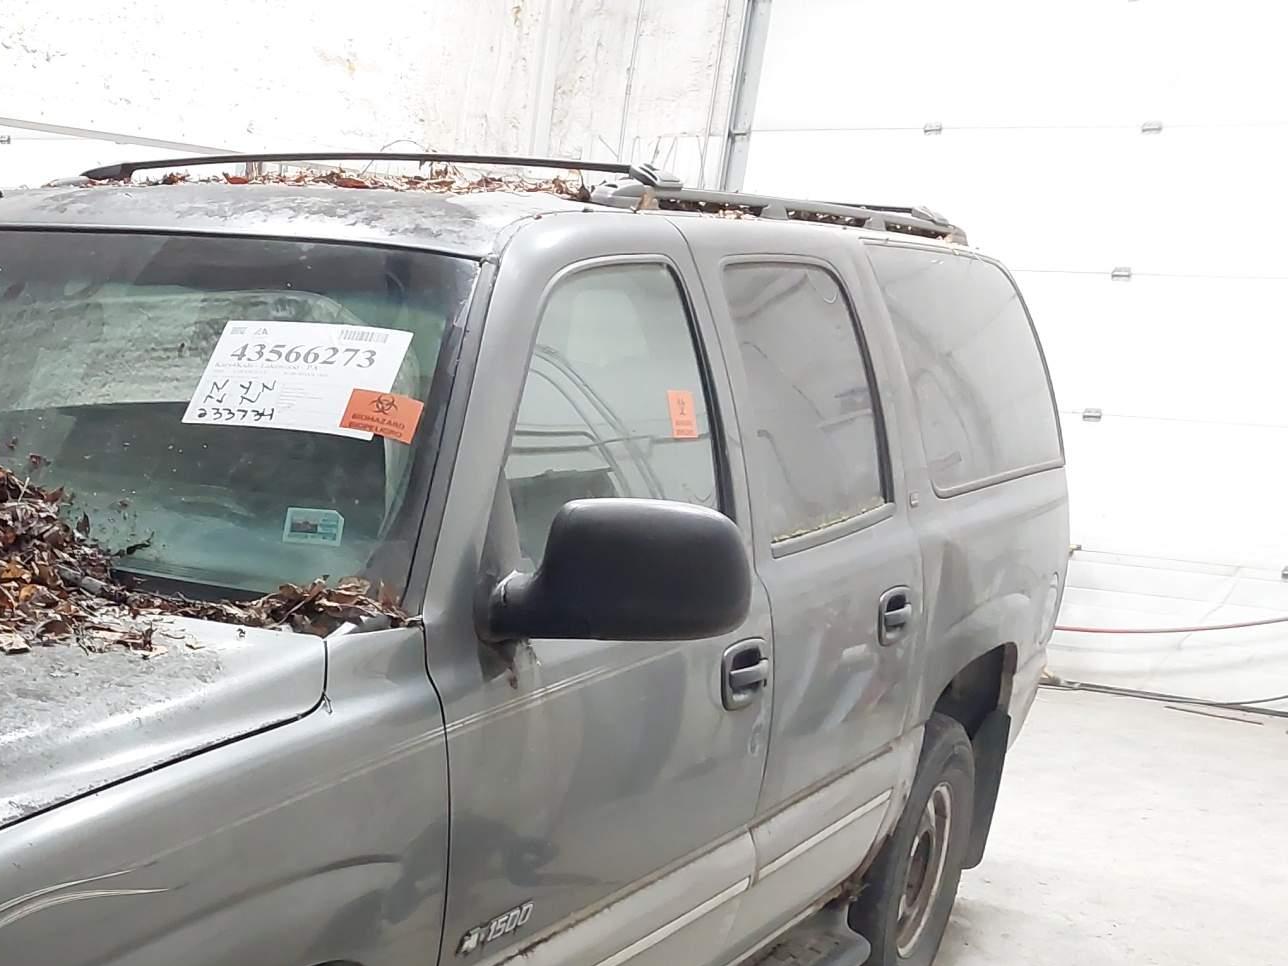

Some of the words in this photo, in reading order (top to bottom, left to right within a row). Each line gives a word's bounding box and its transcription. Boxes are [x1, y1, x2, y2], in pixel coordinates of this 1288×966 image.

[230, 343, 376, 368] 43566273
[198, 407, 274, 421] 233734
[352, 413, 405, 430] BIOHAZARD
[488, 902, 534, 941] 1500
